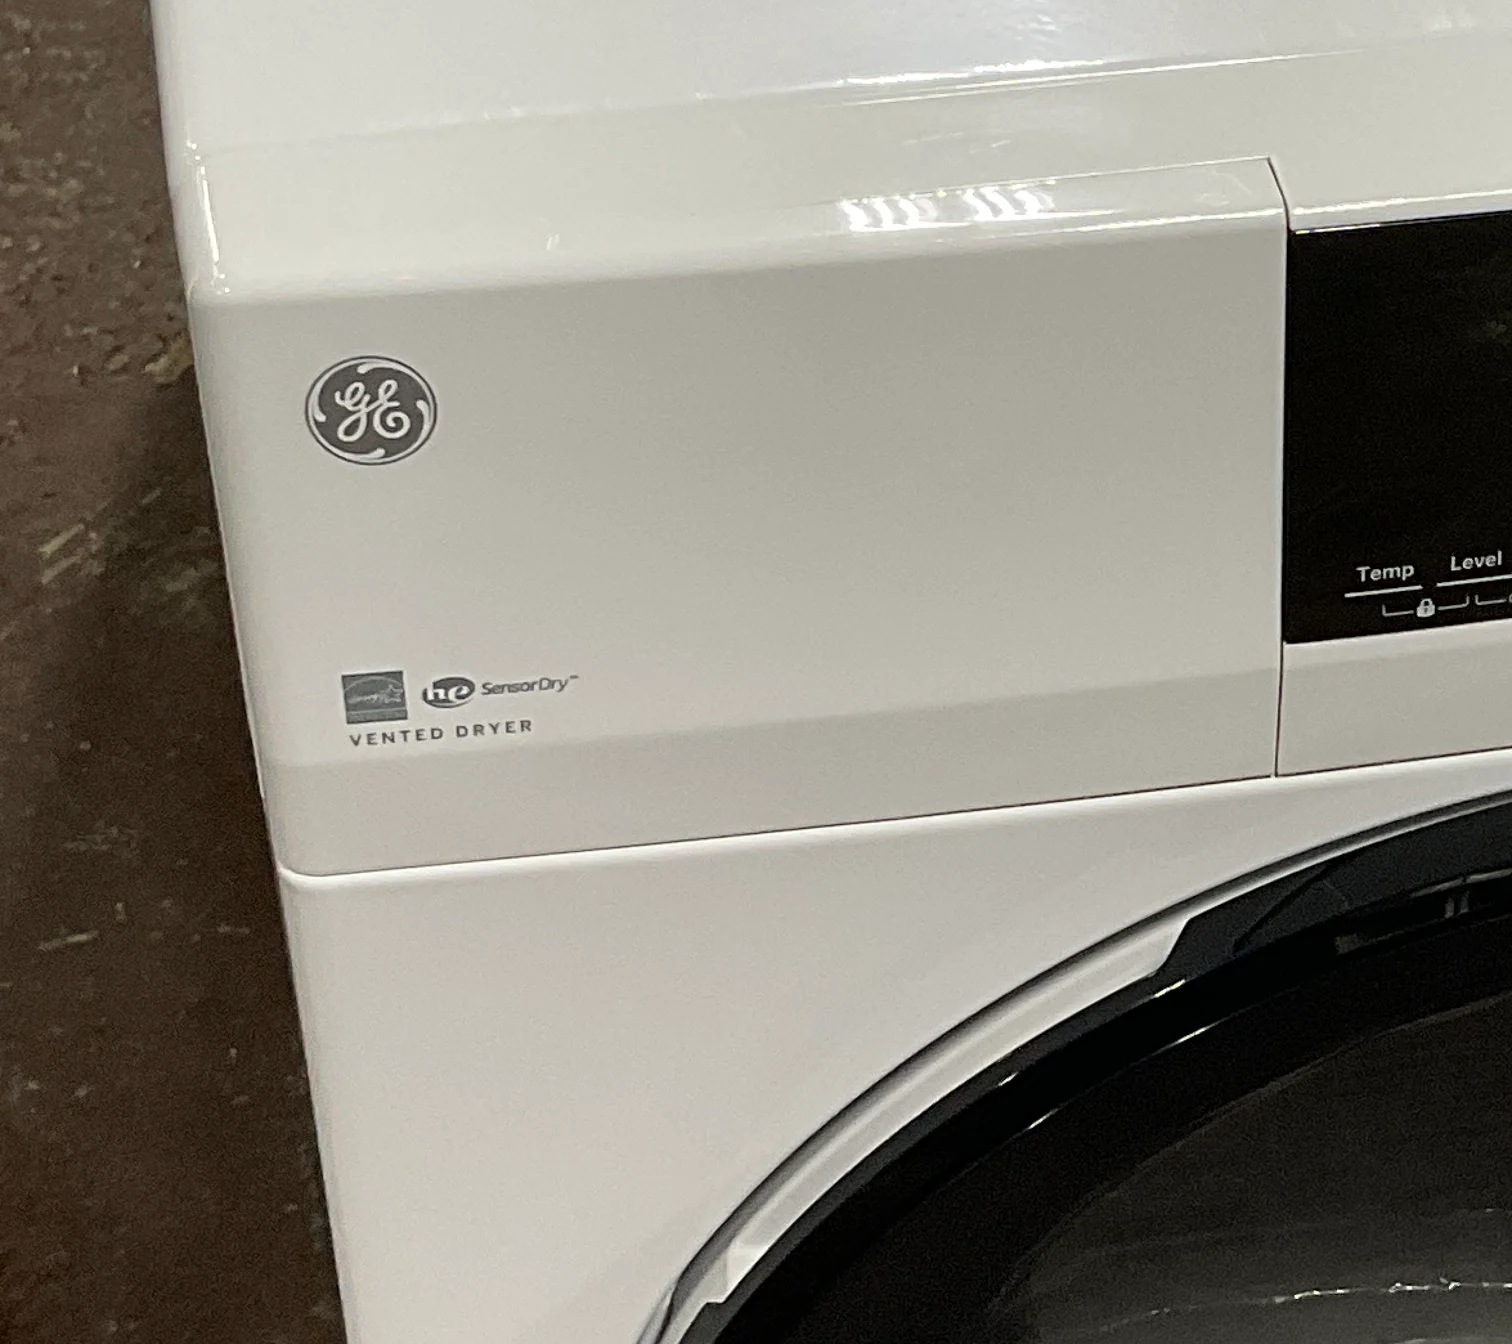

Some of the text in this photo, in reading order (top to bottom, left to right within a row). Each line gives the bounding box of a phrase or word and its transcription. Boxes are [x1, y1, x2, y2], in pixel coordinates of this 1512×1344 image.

[1449, 550, 1503, 572] Level
[1356, 563, 1415, 583] Temp
[349, 719, 533, 748] VENTED DRYER
